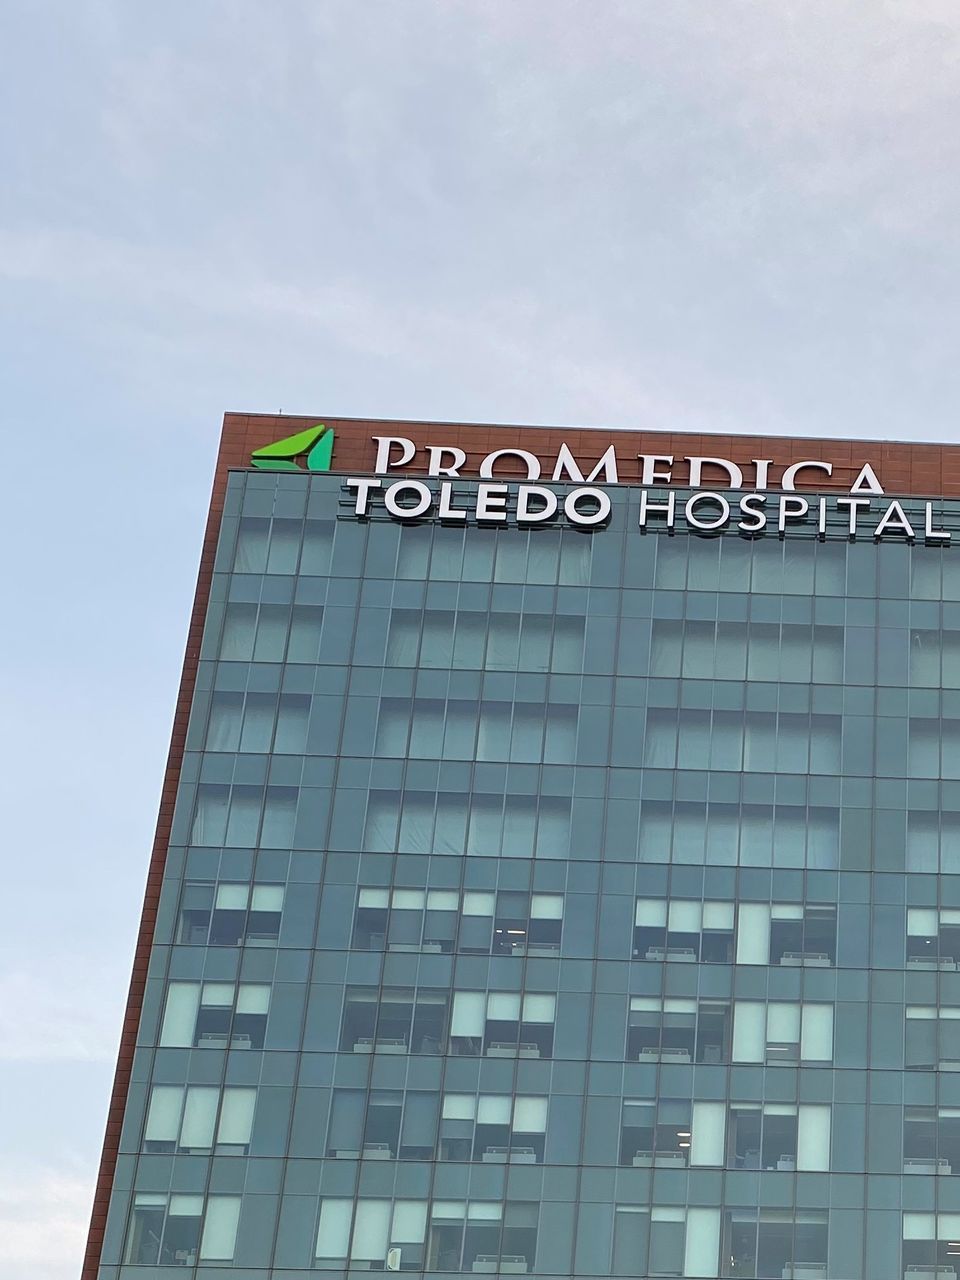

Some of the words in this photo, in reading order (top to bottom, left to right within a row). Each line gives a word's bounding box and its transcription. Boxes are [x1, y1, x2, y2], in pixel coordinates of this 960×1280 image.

[371, 436, 885, 494] PROMEDICA
[345, 477, 612, 525] TOLEDO
[638, 489, 951, 538] HOSPITAL
